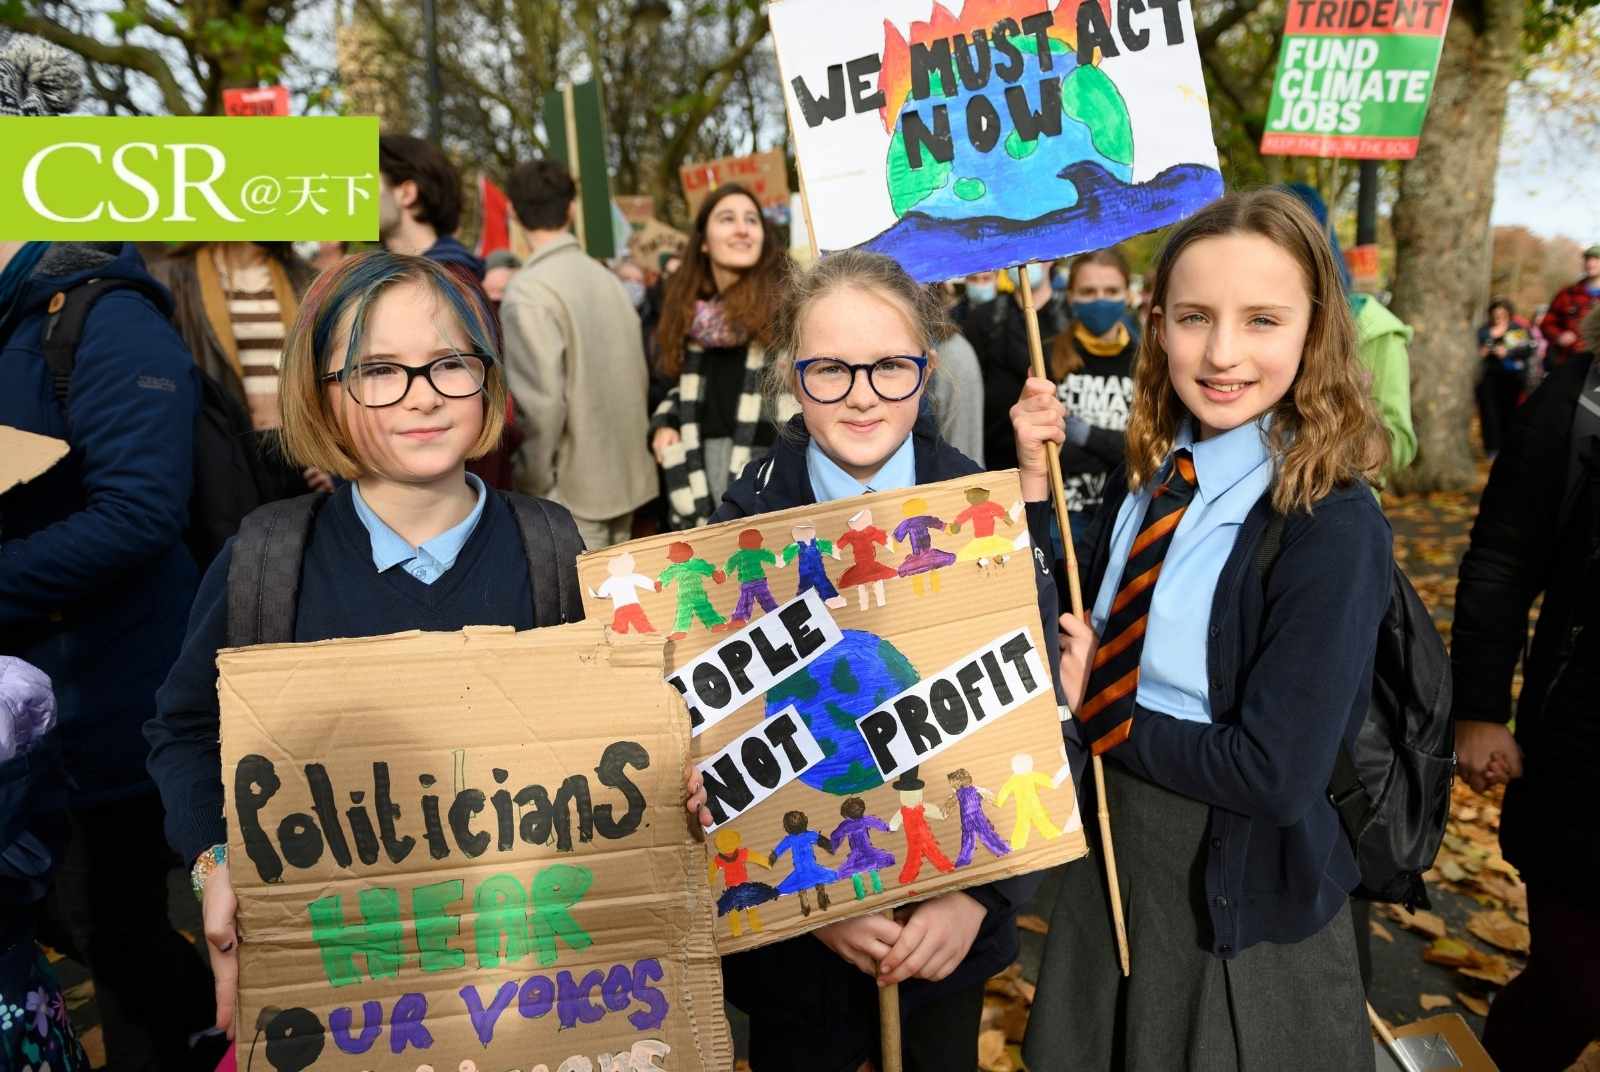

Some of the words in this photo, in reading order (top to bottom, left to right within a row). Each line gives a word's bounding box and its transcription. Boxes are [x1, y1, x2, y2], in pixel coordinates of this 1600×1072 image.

[1284, 38, 1379, 70] FUND
[1297, 0, 1442, 29] TRIDENT
[790, 53, 886, 128] WE
[910, 12, 1055, 100] MUST
[1076, 0, 1185, 64] ACT
[1279, 70, 1430, 103] CLIMATE
[902, 78, 1064, 169] NOW
[1271, 100, 1363, 133] JOBS
[668, 598, 828, 729] OPLE
[858, 631, 1037, 776] PROFIT
[702, 713, 808, 826] NOT
[308, 864, 593, 987] HEAR
[264, 993, 433, 1072] OUR
